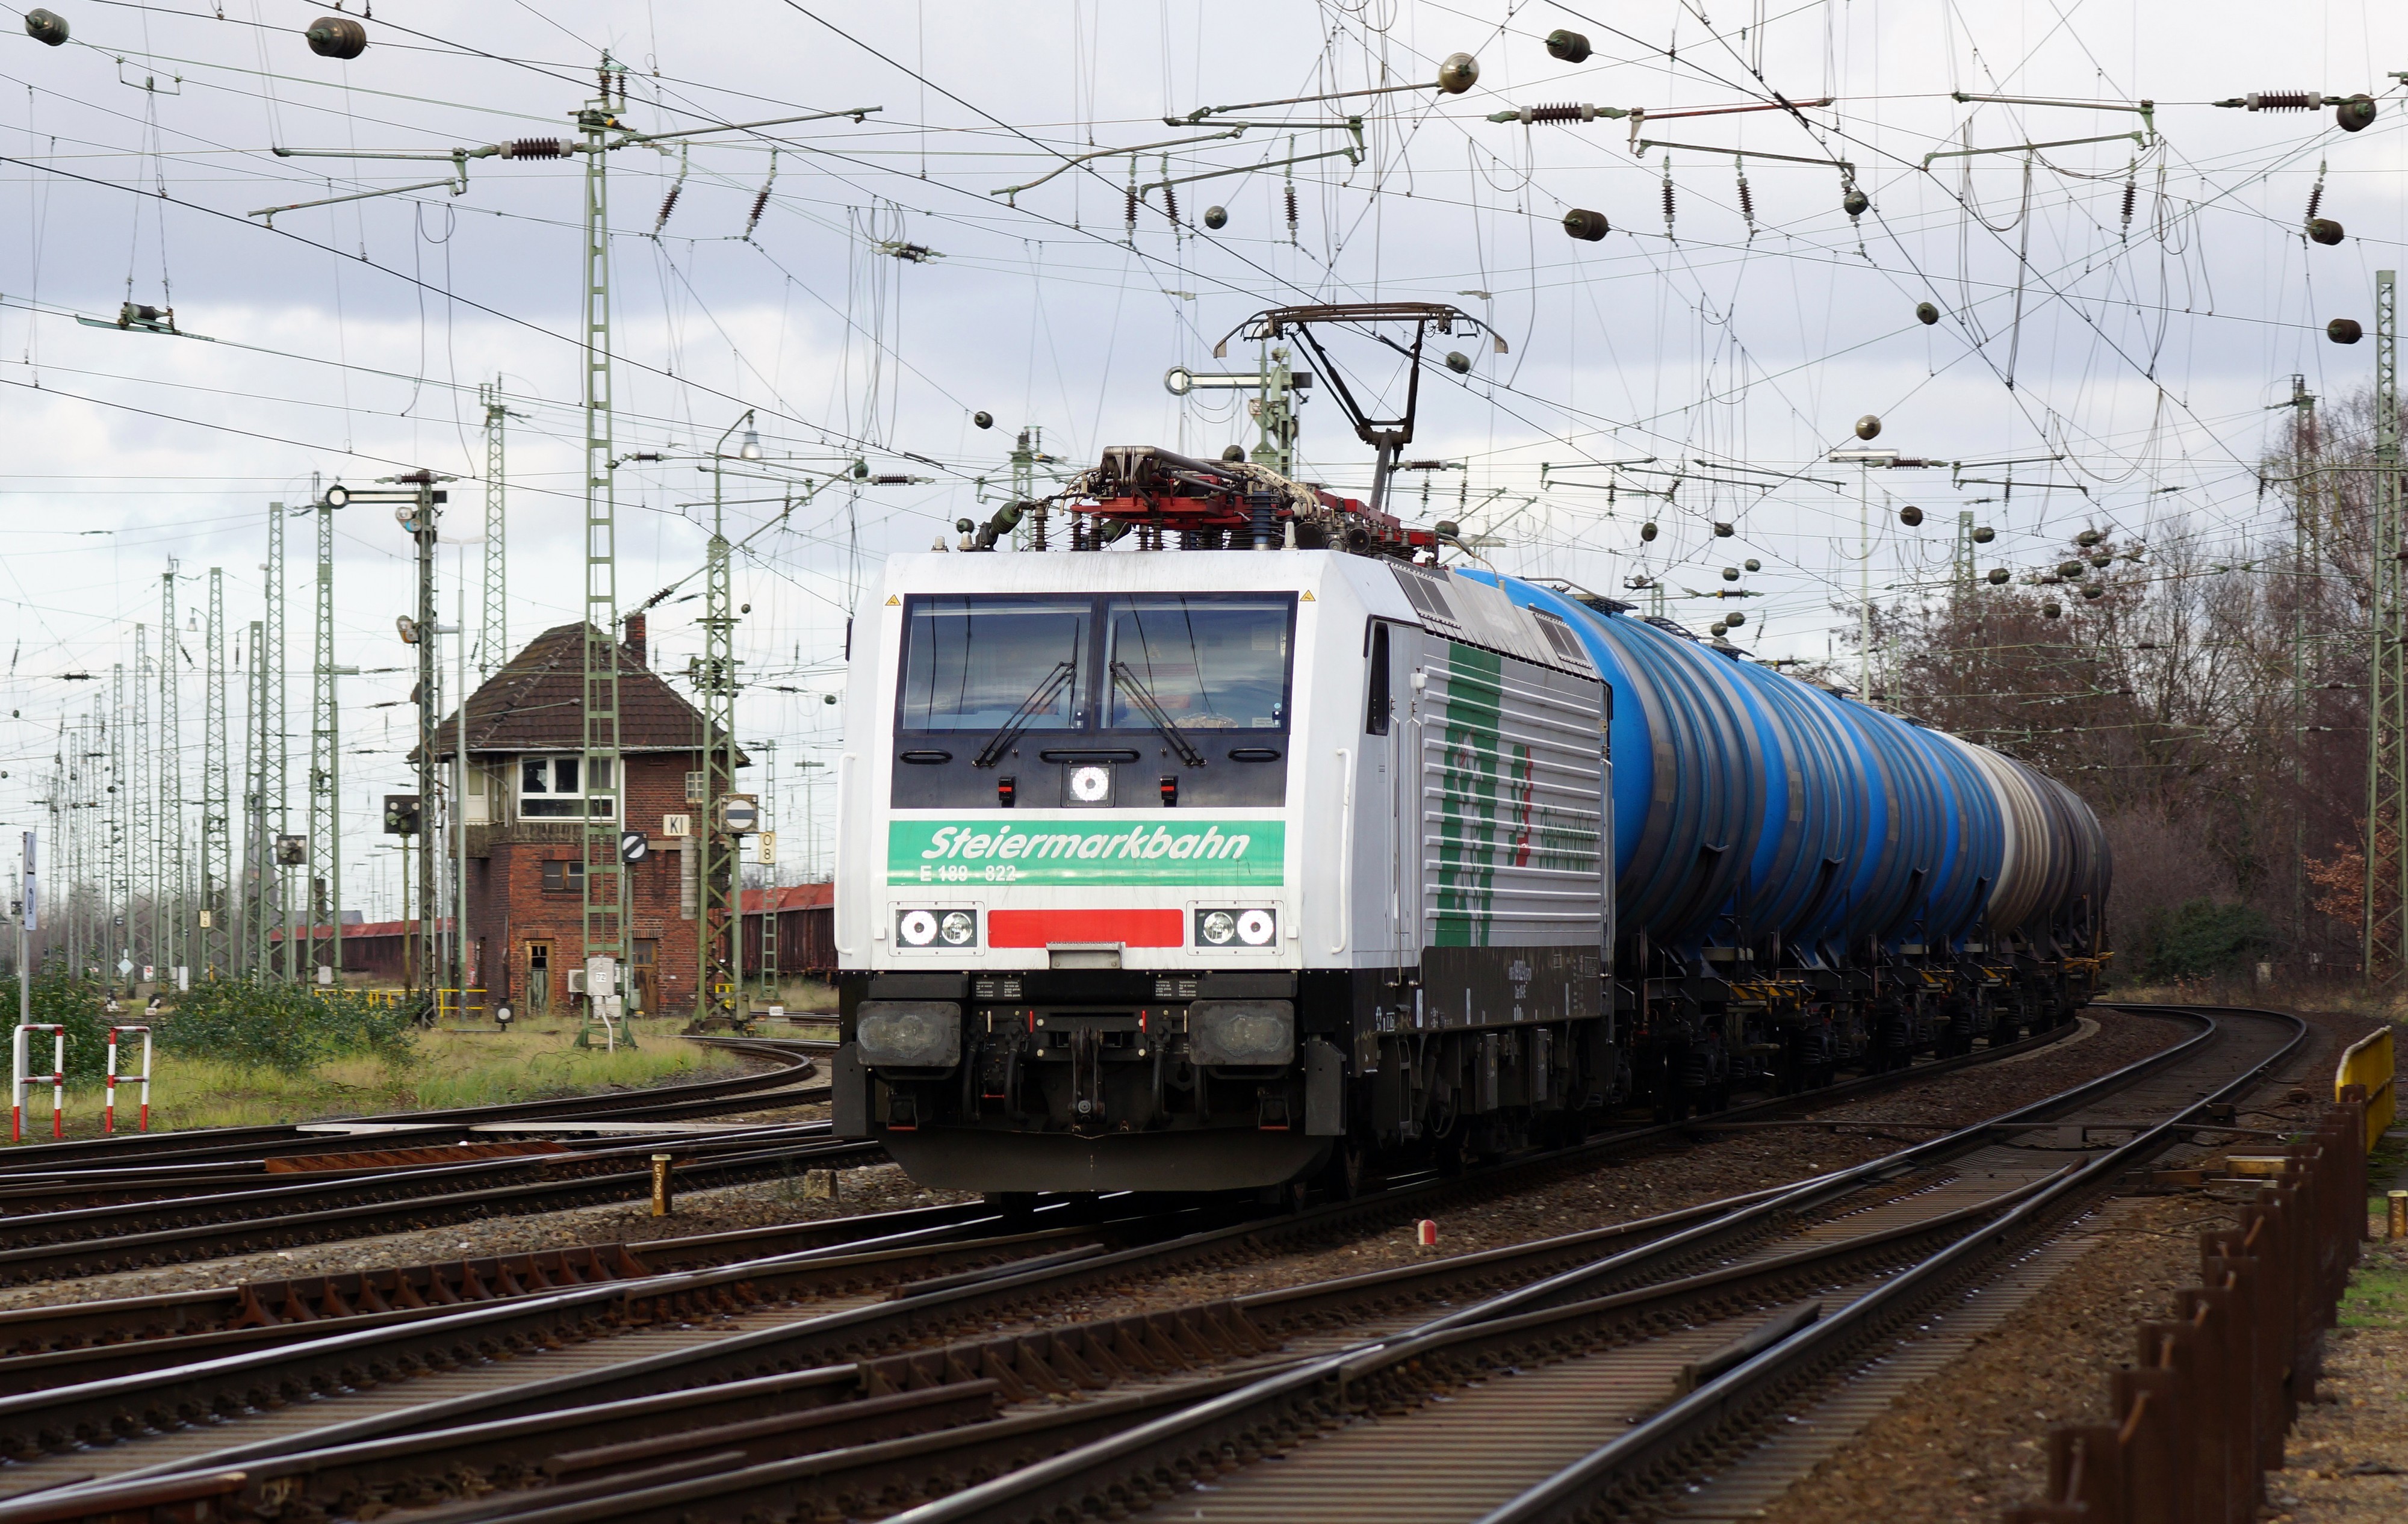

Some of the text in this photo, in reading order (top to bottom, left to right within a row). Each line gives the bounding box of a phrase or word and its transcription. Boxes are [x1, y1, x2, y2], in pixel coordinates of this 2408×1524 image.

[921, 825, 1250, 859] Steiermarkbahn
[920, 865, 1016, 881] E 189 822
